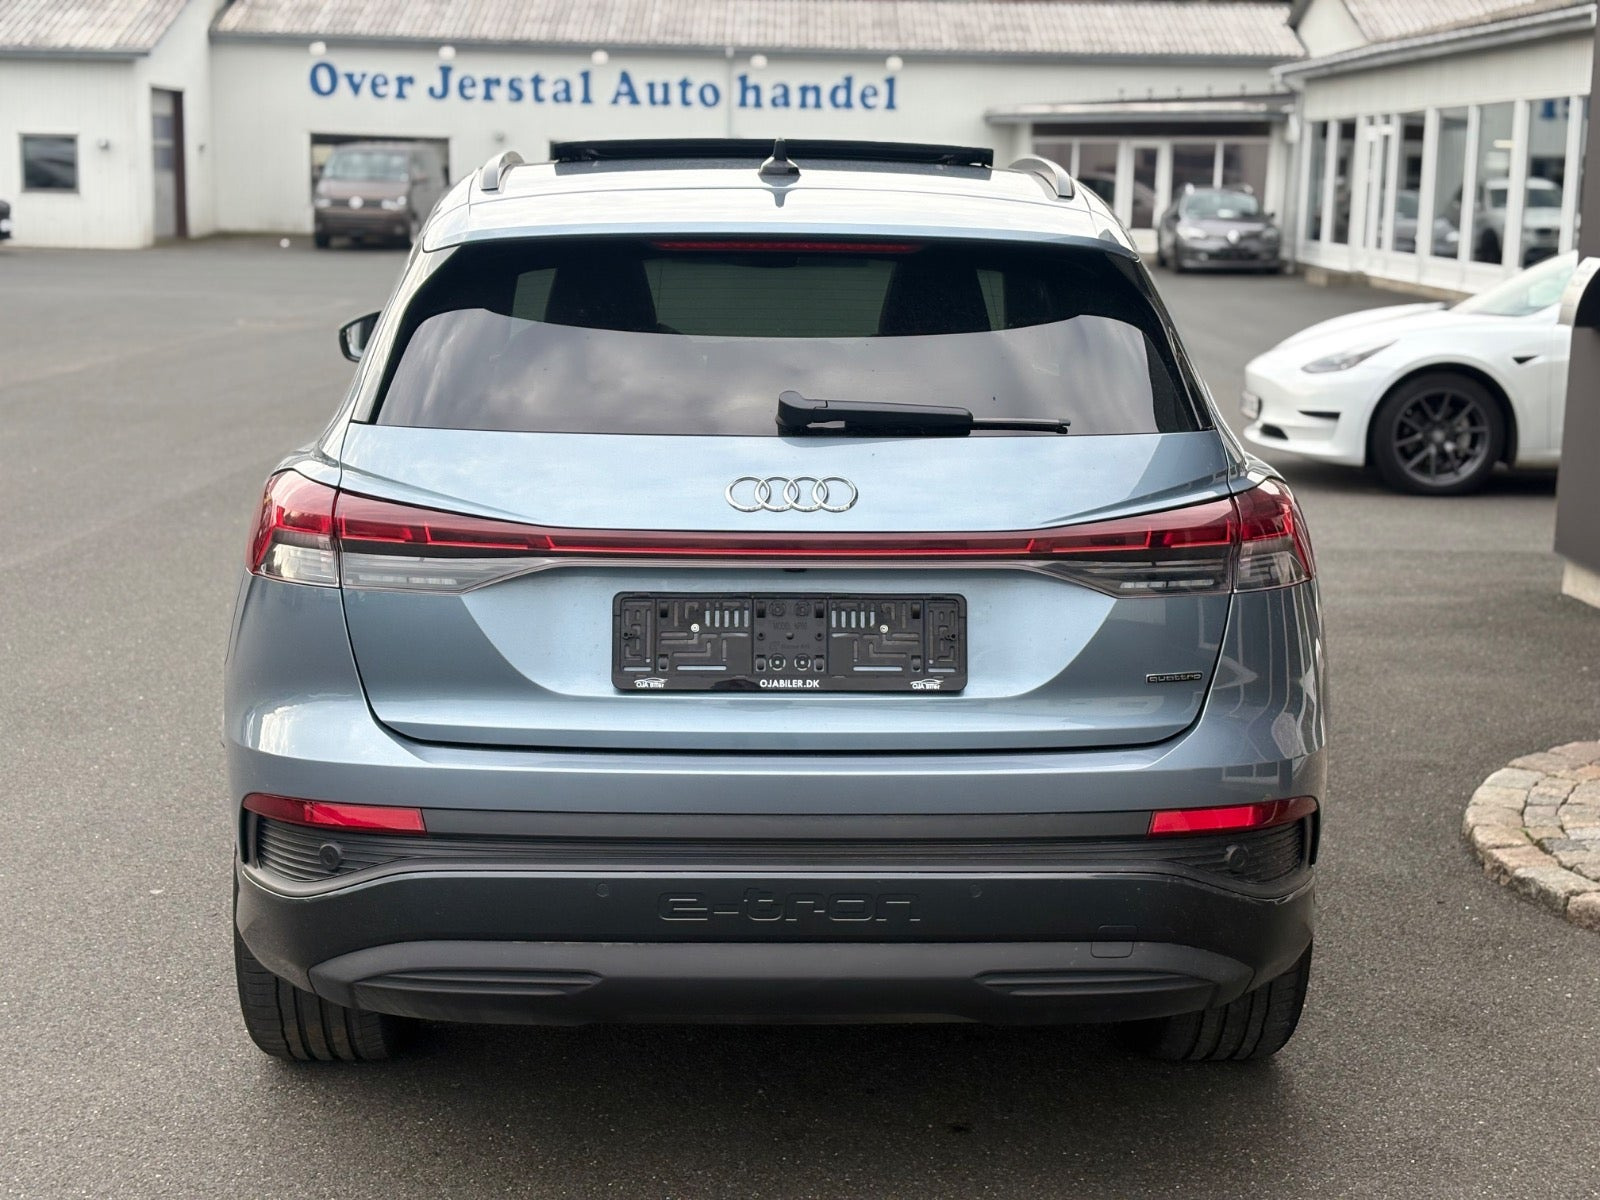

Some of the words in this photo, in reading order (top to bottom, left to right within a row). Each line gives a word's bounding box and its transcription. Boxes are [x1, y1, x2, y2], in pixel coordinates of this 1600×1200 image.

[308, 62, 415, 99] Over
[427, 65, 592, 105] Jerstal
[611, 70, 722, 107] Auto
[737, 74, 898, 110] handel
[759, 679, 820, 688] OJABILER.DK
[1149, 673, 1202, 683] quattro
[658, 888, 921, 922] e-tron
